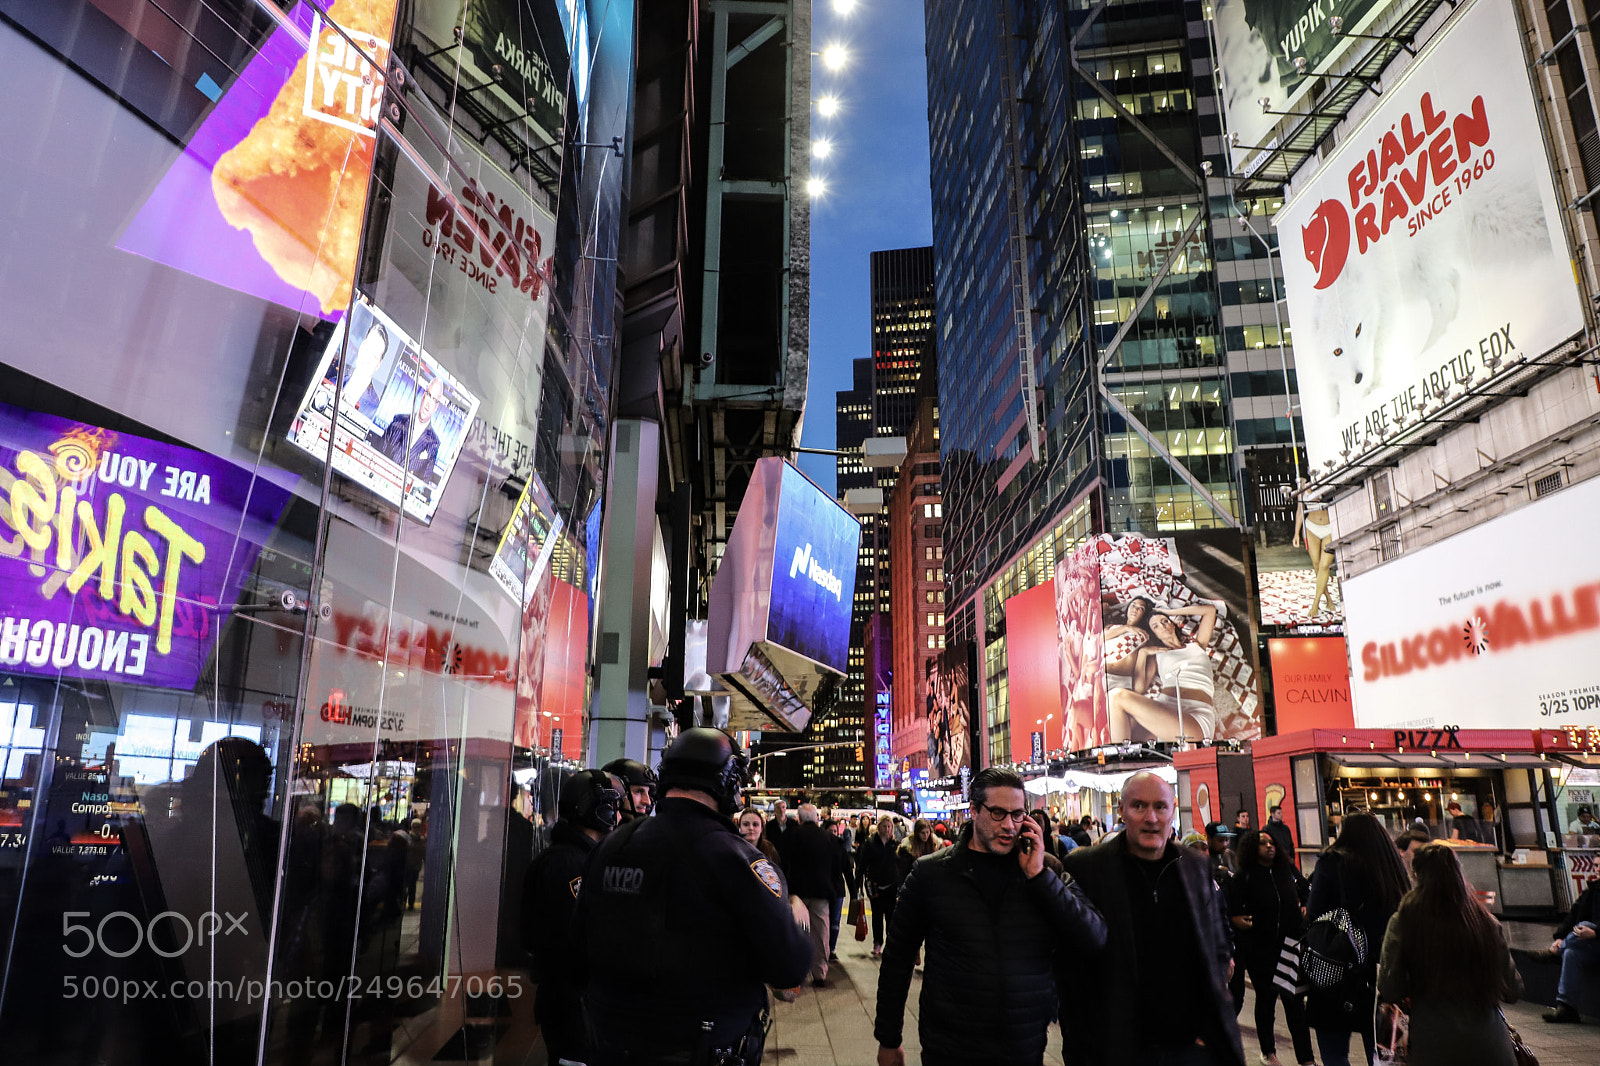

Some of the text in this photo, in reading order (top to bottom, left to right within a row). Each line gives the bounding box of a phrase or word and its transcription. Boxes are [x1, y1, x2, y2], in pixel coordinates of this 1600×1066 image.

[1280, 0, 1326, 61] YUPIK
[1348, 92, 1446, 209] FJÄLL
[1355, 95, 1490, 255] RÄVEN
[1408, 149, 1495, 237] SINCE 1960
[1341, 322, 1516, 450] WE ARE THE ARCTIC FOX
[808, 556, 842, 603] Nasdaq
[1438, 580, 1503, 606] The future is now.
[1361, 624, 1475, 682] SILICON
[1284, 673, 1332, 684] OUR FAMILY
[1286, 688, 1347, 704] CALVIN
[1538, 690, 1566, 700] SEASON
[1540, 699, 1569, 717] 3/25
[52, 846, 75, 854] VALUE
[78, 846, 107, 855] 7,273.01
[603, 866, 645, 888] NYPD
